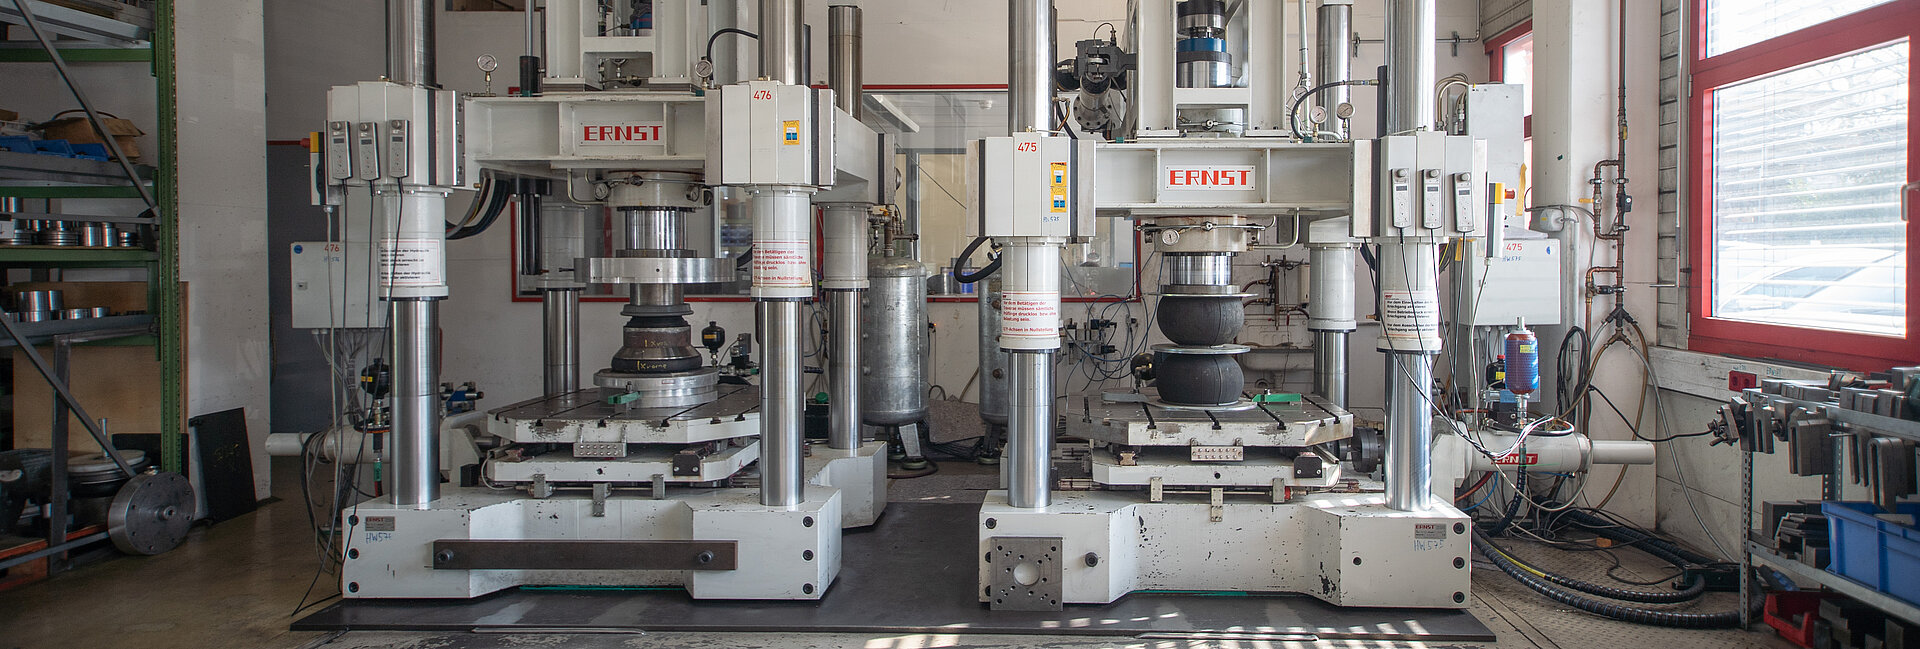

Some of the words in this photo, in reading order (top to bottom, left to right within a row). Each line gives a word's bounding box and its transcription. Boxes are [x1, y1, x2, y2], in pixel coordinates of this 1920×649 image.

[753, 90, 772, 100] 476
[584, 126, 663, 141] ERNST
[1017, 142, 1037, 152] 475
[1169, 170, 1251, 185] ERNST
[324, 244, 340, 252] 476
[1506, 243, 1523, 251] 475
[1495, 456, 1533, 464] RNT
